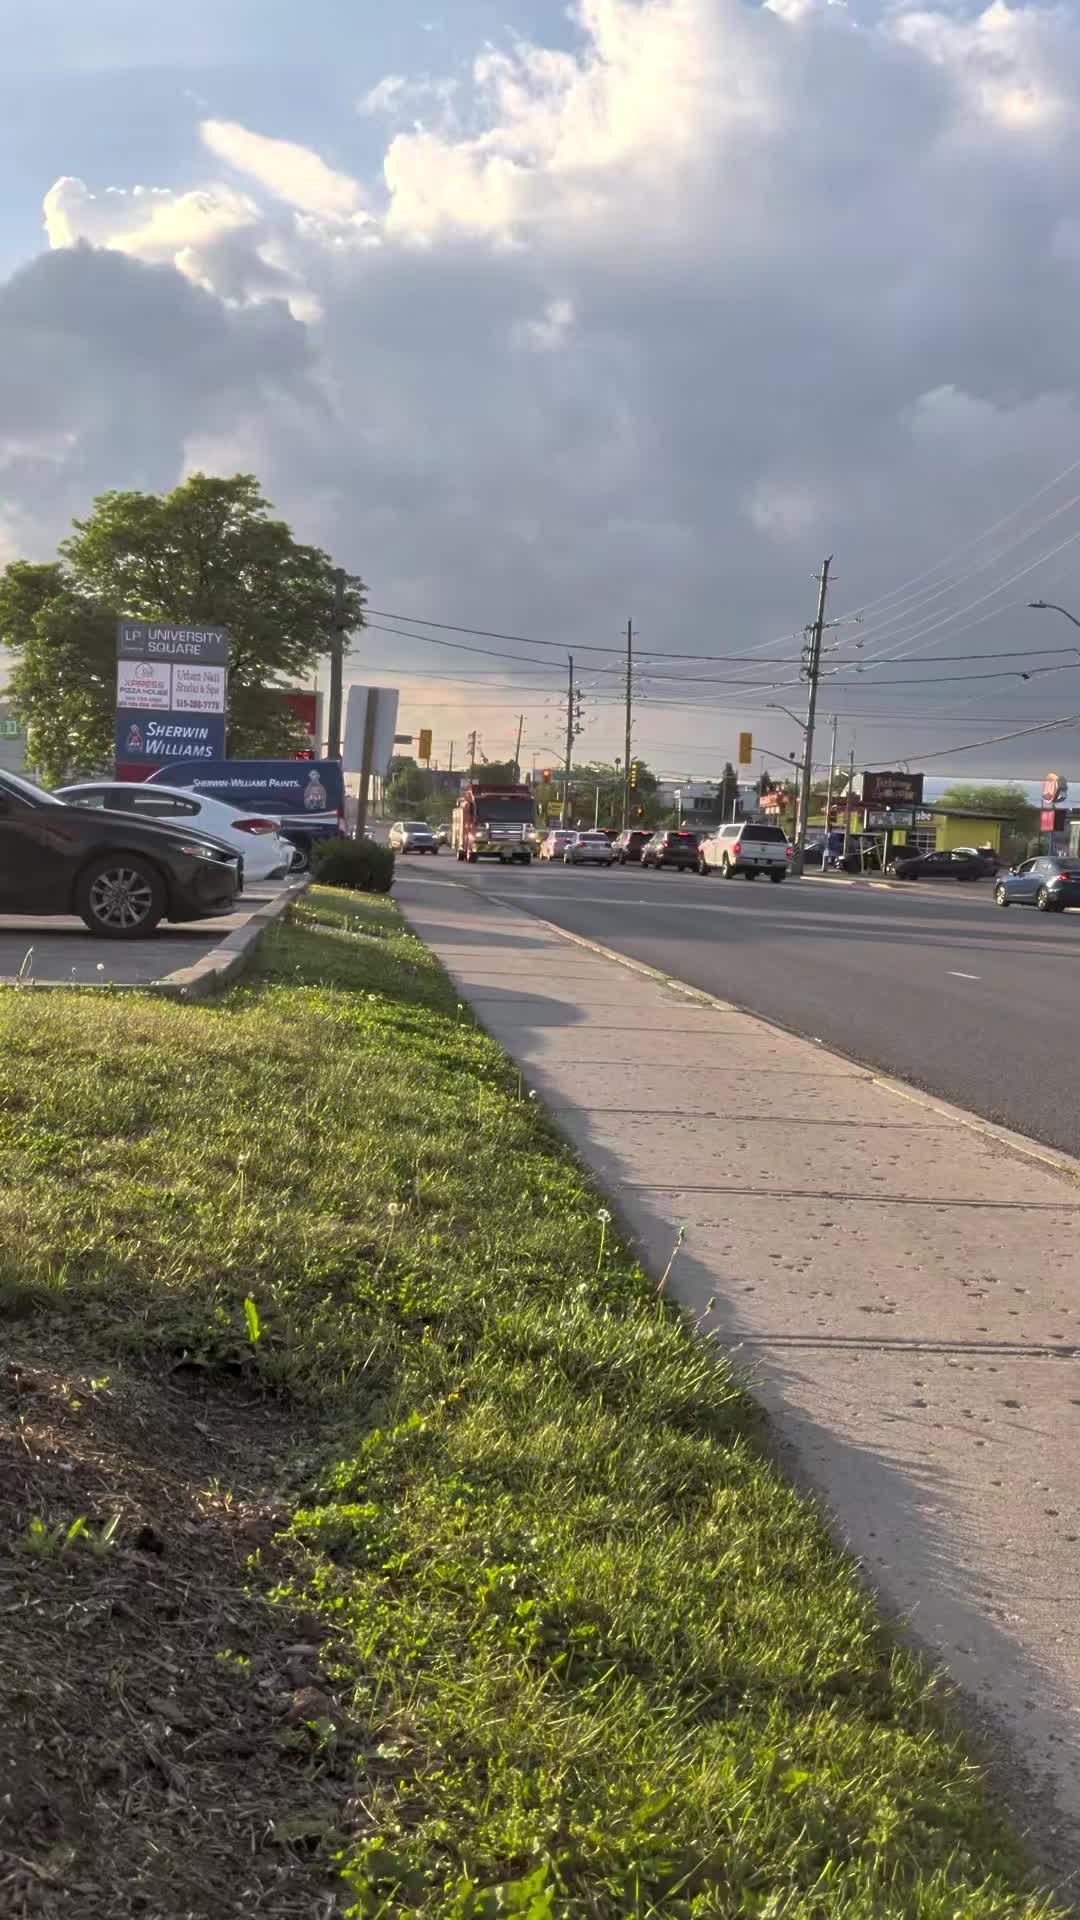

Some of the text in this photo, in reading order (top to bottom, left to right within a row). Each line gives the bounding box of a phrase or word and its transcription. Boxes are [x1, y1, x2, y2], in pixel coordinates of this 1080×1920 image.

[148, 629, 222, 643] UNIVERSITY
[148, 642, 201, 655] SQUARE
[146, 721, 209, 740] SHERWIN
[145, 739, 213, 758] WILLIAMS
